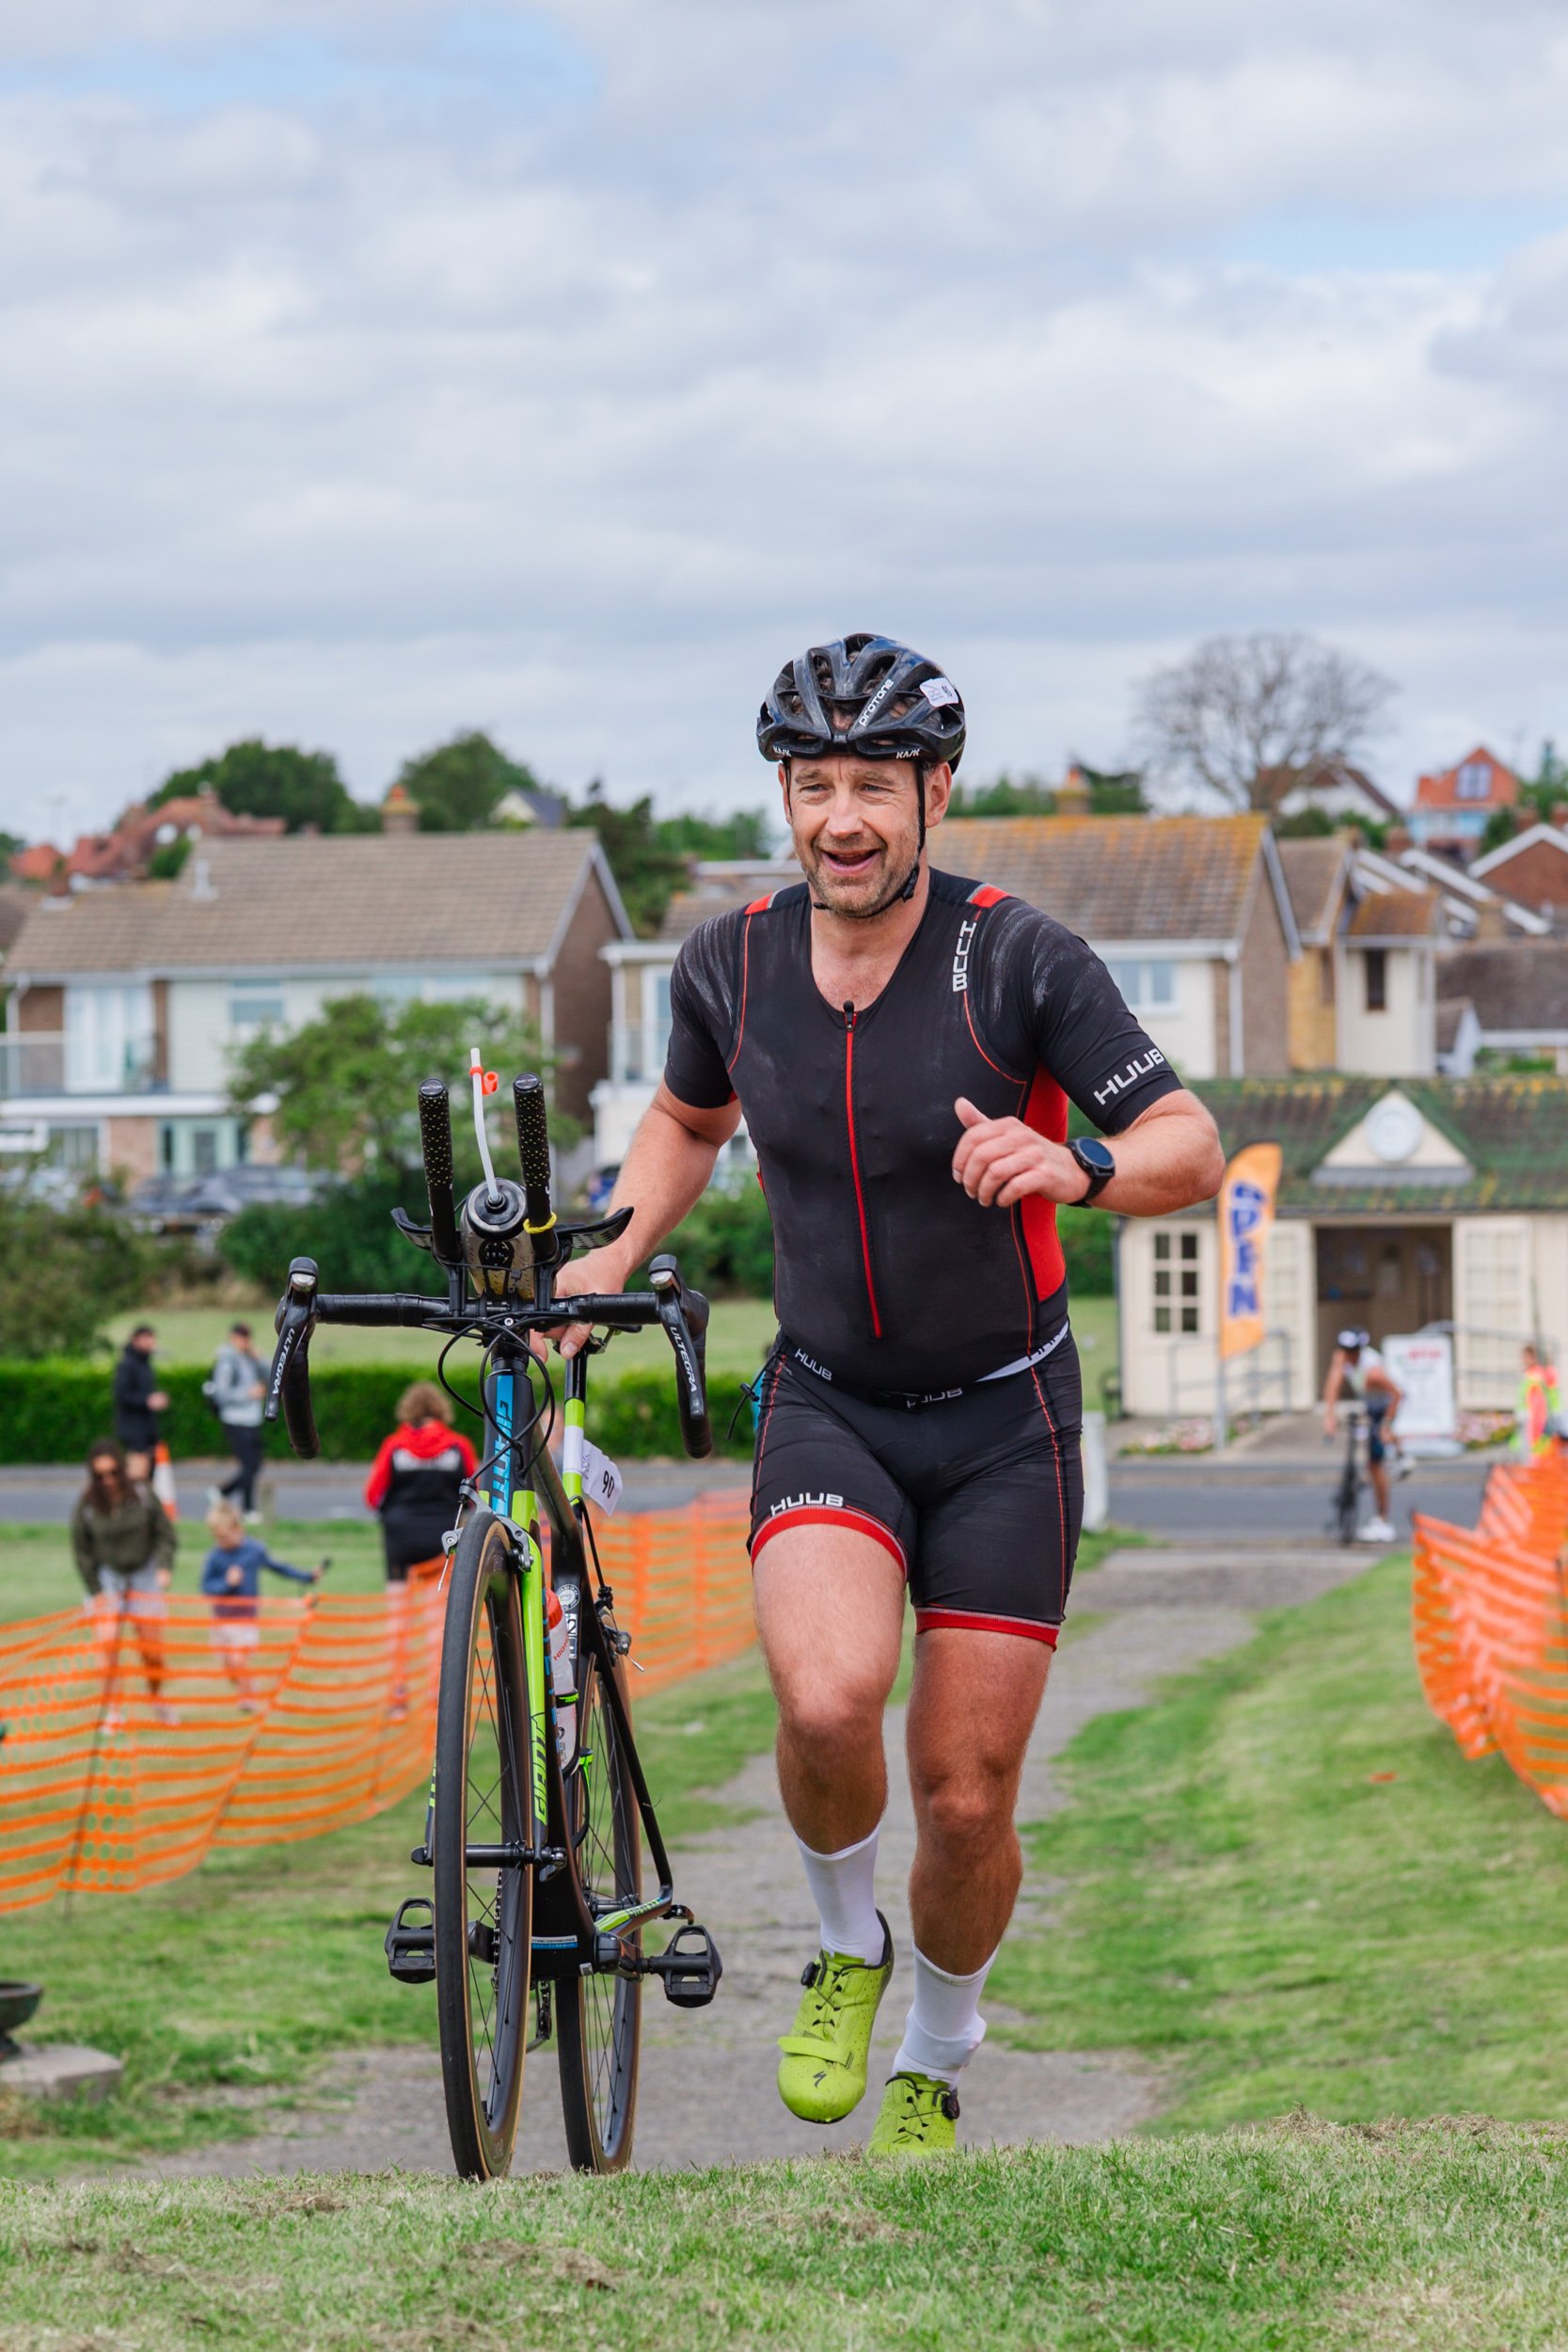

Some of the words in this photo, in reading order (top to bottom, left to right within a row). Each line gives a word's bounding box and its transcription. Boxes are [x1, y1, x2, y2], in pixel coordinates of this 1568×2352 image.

[952, 919, 977, 993] HUUB
[1093, 1047, 1165, 1105] HUUB
[272, 1327, 295, 1395] ULTEGRA
[670, 1326, 698, 1392] ULTEGRA
[795, 1348, 832, 1382] HUUB
[602, 1470, 615, 1499] 90
[769, 1492, 844, 1517] HUUB
[532, 1718, 548, 1826] GIANT
